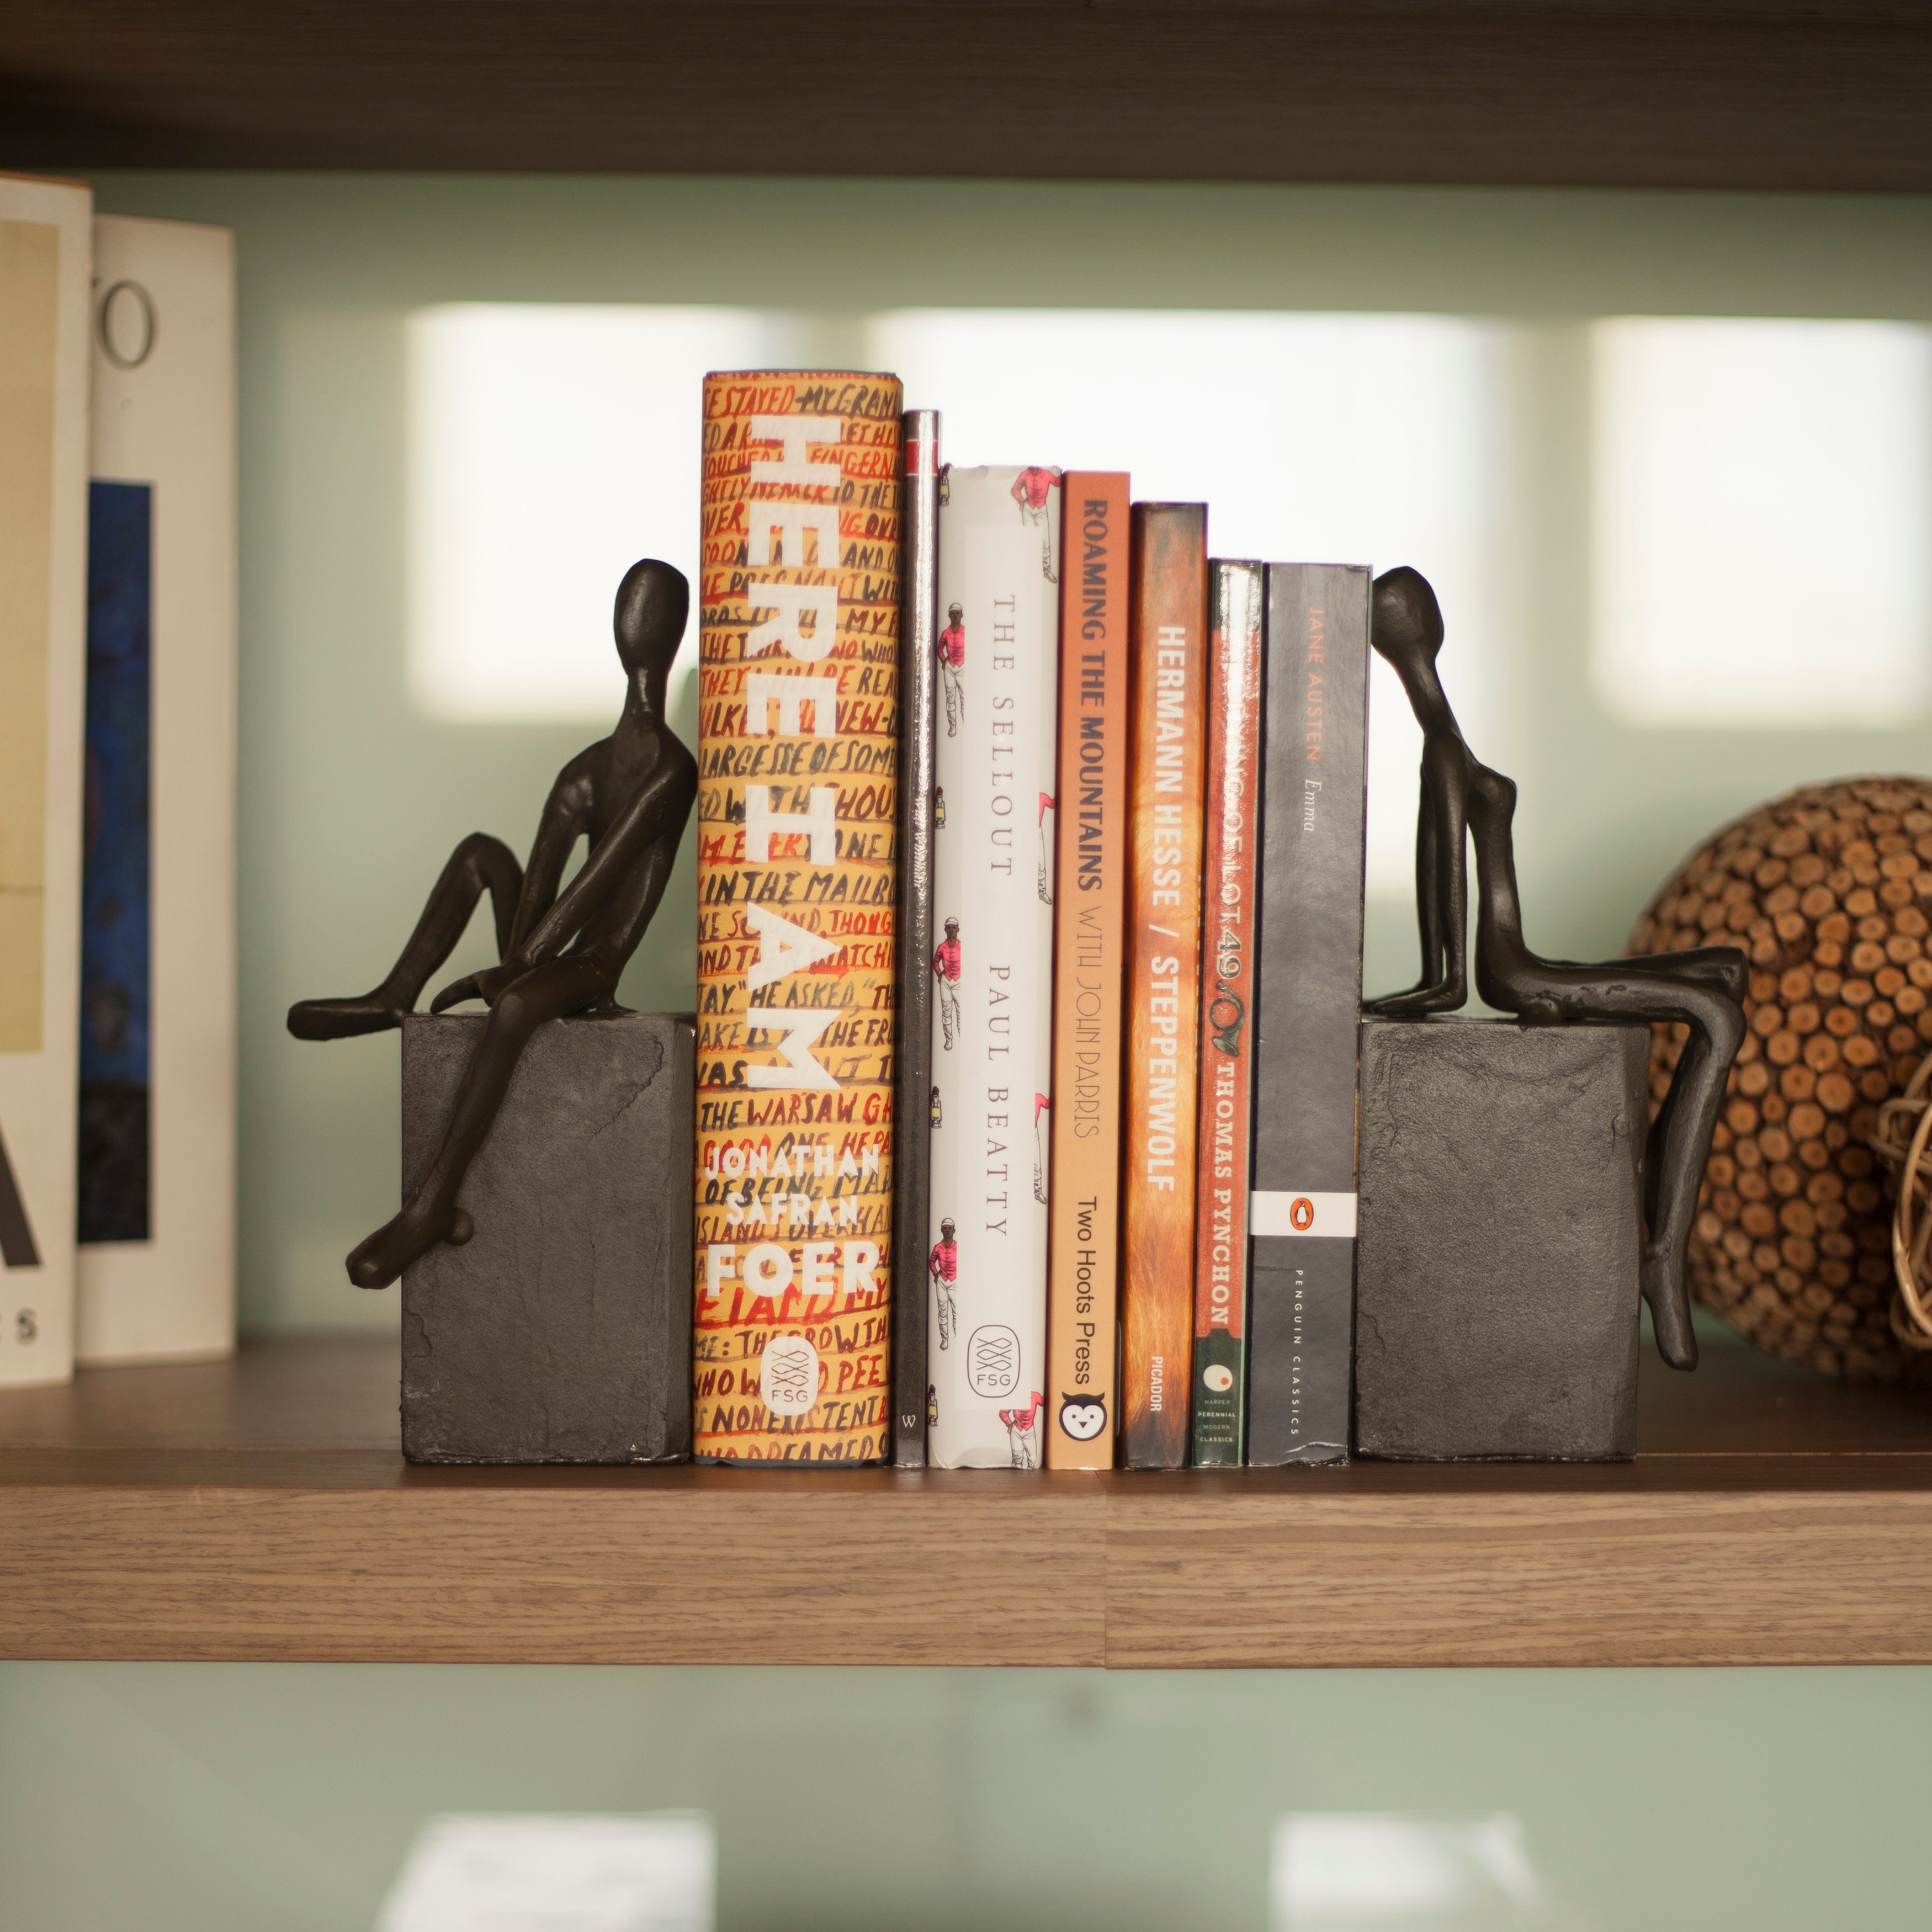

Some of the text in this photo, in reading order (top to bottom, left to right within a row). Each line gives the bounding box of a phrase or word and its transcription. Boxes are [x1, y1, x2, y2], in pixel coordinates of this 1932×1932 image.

[723, 385, 795, 420] STAYED
[747, 415, 841, 738] HERE
[842, 542, 884, 570] AND
[845, 608, 887, 635] MY
[702, 633, 734, 666] THE
[701, 665, 751, 698] THEY
[1305, 604, 1324, 761] JANE AUSTEN
[1154, 627, 1186, 792] HERMANN
[700, 741, 811, 779] LARGESSE
[809, 741, 845, 774] OF
[725, 782, 811, 826] WTH
[745, 785, 835, 866] I
[1074, 499, 1108, 1138] ROAMING THE MOUNTAINS WITH JOHN PARRIS
[1303, 778, 1323, 832] Emma
[1152, 804, 1182, 906] HESSE
[705, 870, 739, 907] IN
[742, 870, 802, 906] THE
[986, 594, 1016, 1236] THE SELLOUT PAUL BEATTY
[1217, 928, 1241, 980] 49
[747, 902, 842, 1090] AM
[749, 981, 782, 1008] HE
[1147, 956, 1180, 1191] STEPPENWOLF
[701, 1100, 744, 1133] THE
[747, 1091, 859, 1127] WARSAW
[704, 1144, 879, 1180] JONATHAN
[705, 1179, 737, 1206] OF
[726, 1192, 857, 1226] SAFRAN
[1211, 1061, 1235, 1325] THOMAS PYNCHON
[707, 1241, 880, 1297] FOER
[1075, 1196, 1097, 1385] Two Hoots Press
[1291, 1270, 1303, 1435] PENGUIN CLASSICS
[772, 1389, 808, 1403] FSG
[976, 1373, 1011, 1386] FSG
[1150, 1356, 1164, 1412] PICADOR
